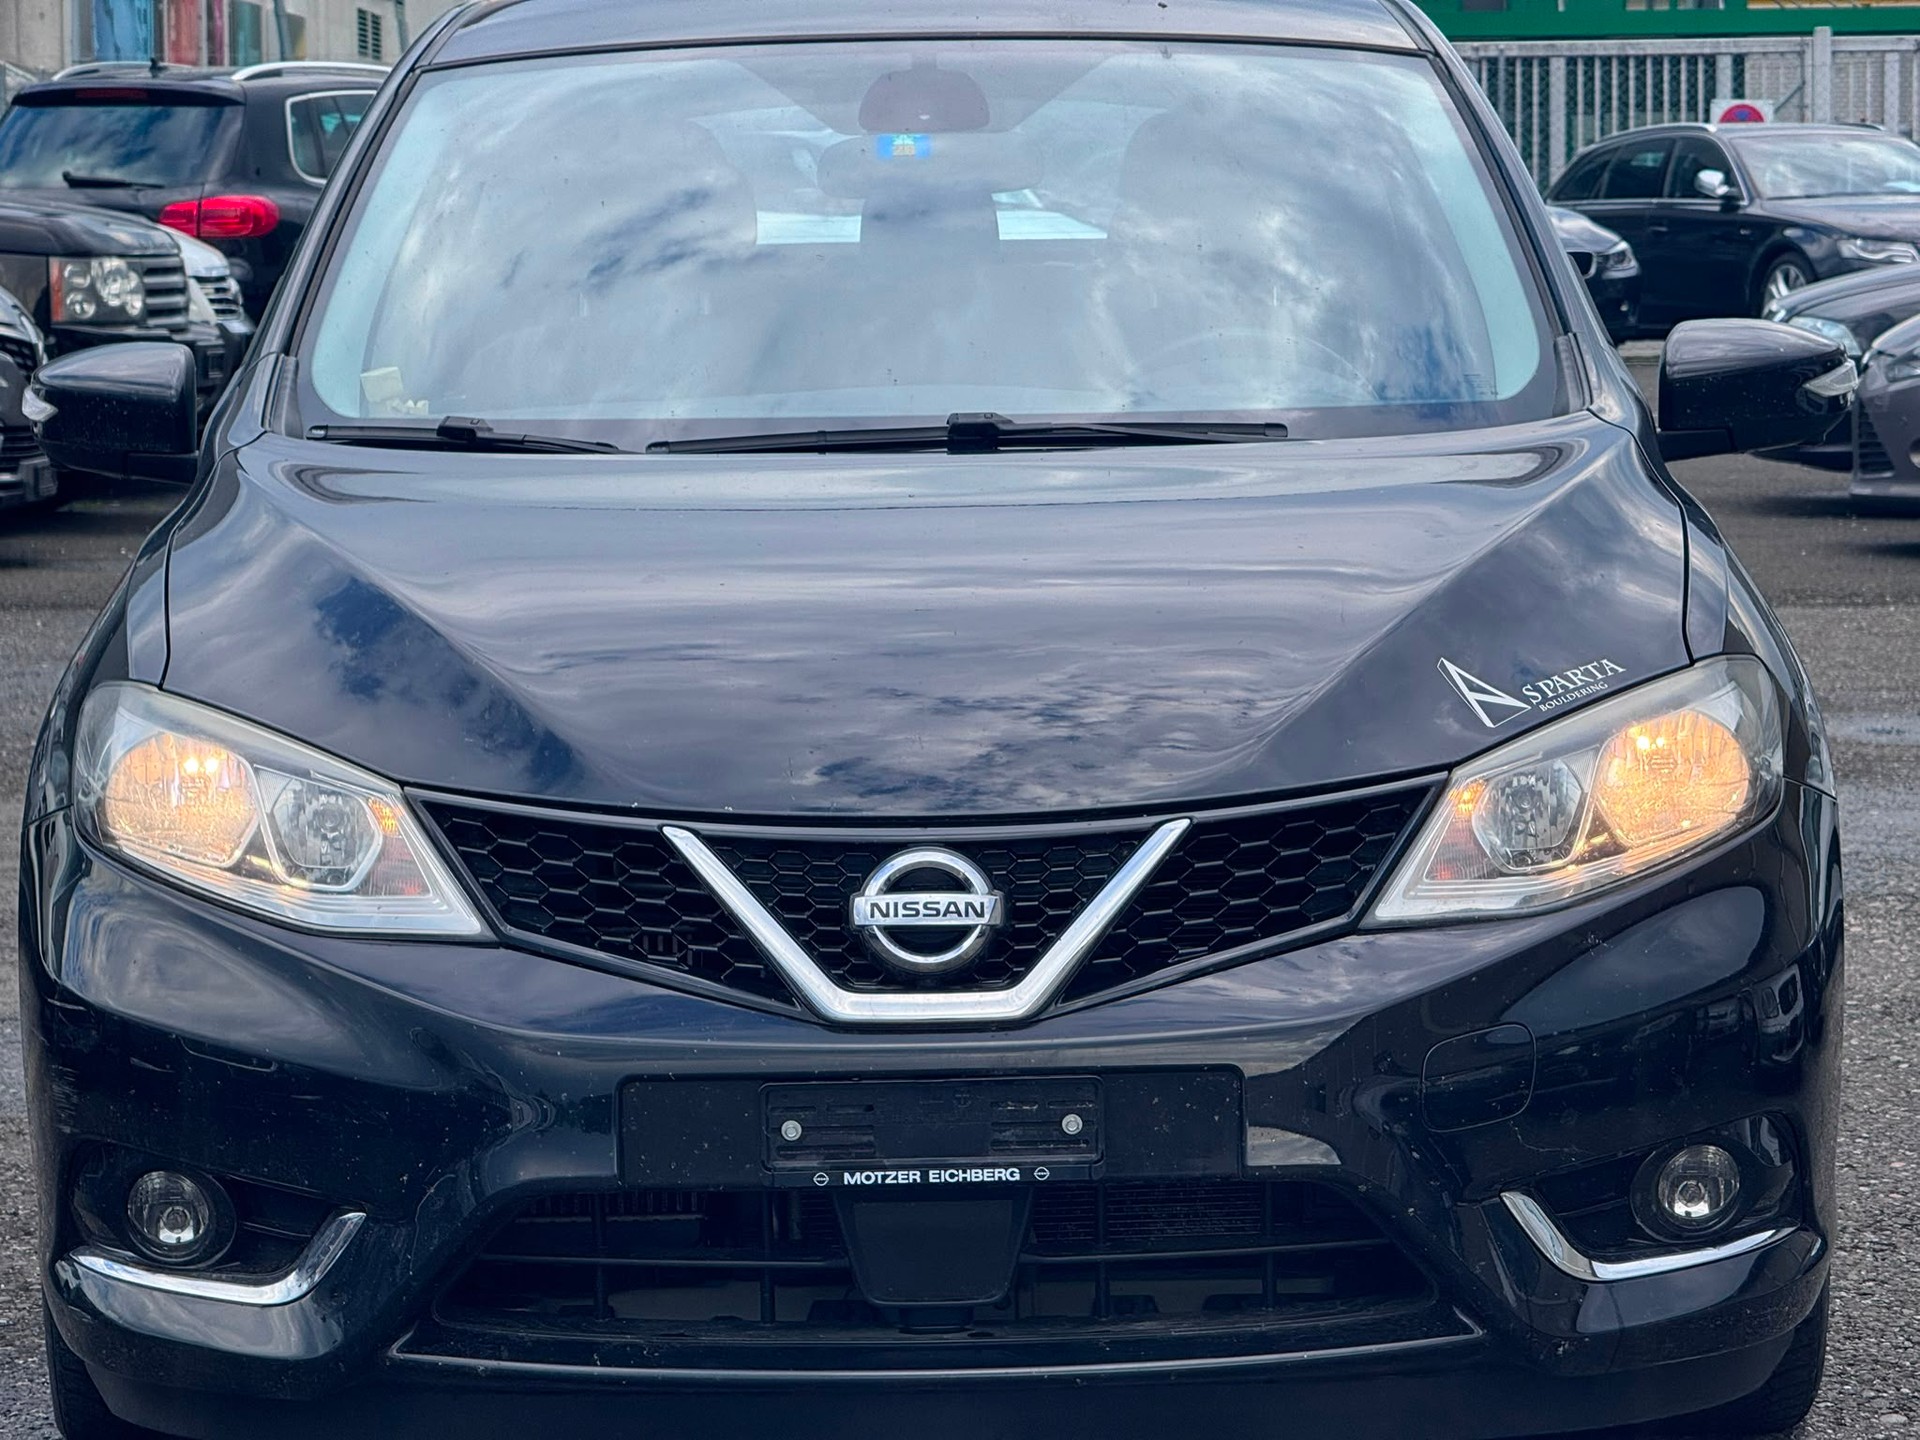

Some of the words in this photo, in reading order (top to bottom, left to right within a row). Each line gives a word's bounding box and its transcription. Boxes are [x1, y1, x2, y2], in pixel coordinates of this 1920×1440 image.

[1539, 681, 1609, 712] BOULDERING
[869, 900, 985, 919] NISSAN
[843, 1170, 921, 1185] MOTZER
[928, 1167, 1020, 1183] EICHBERG
